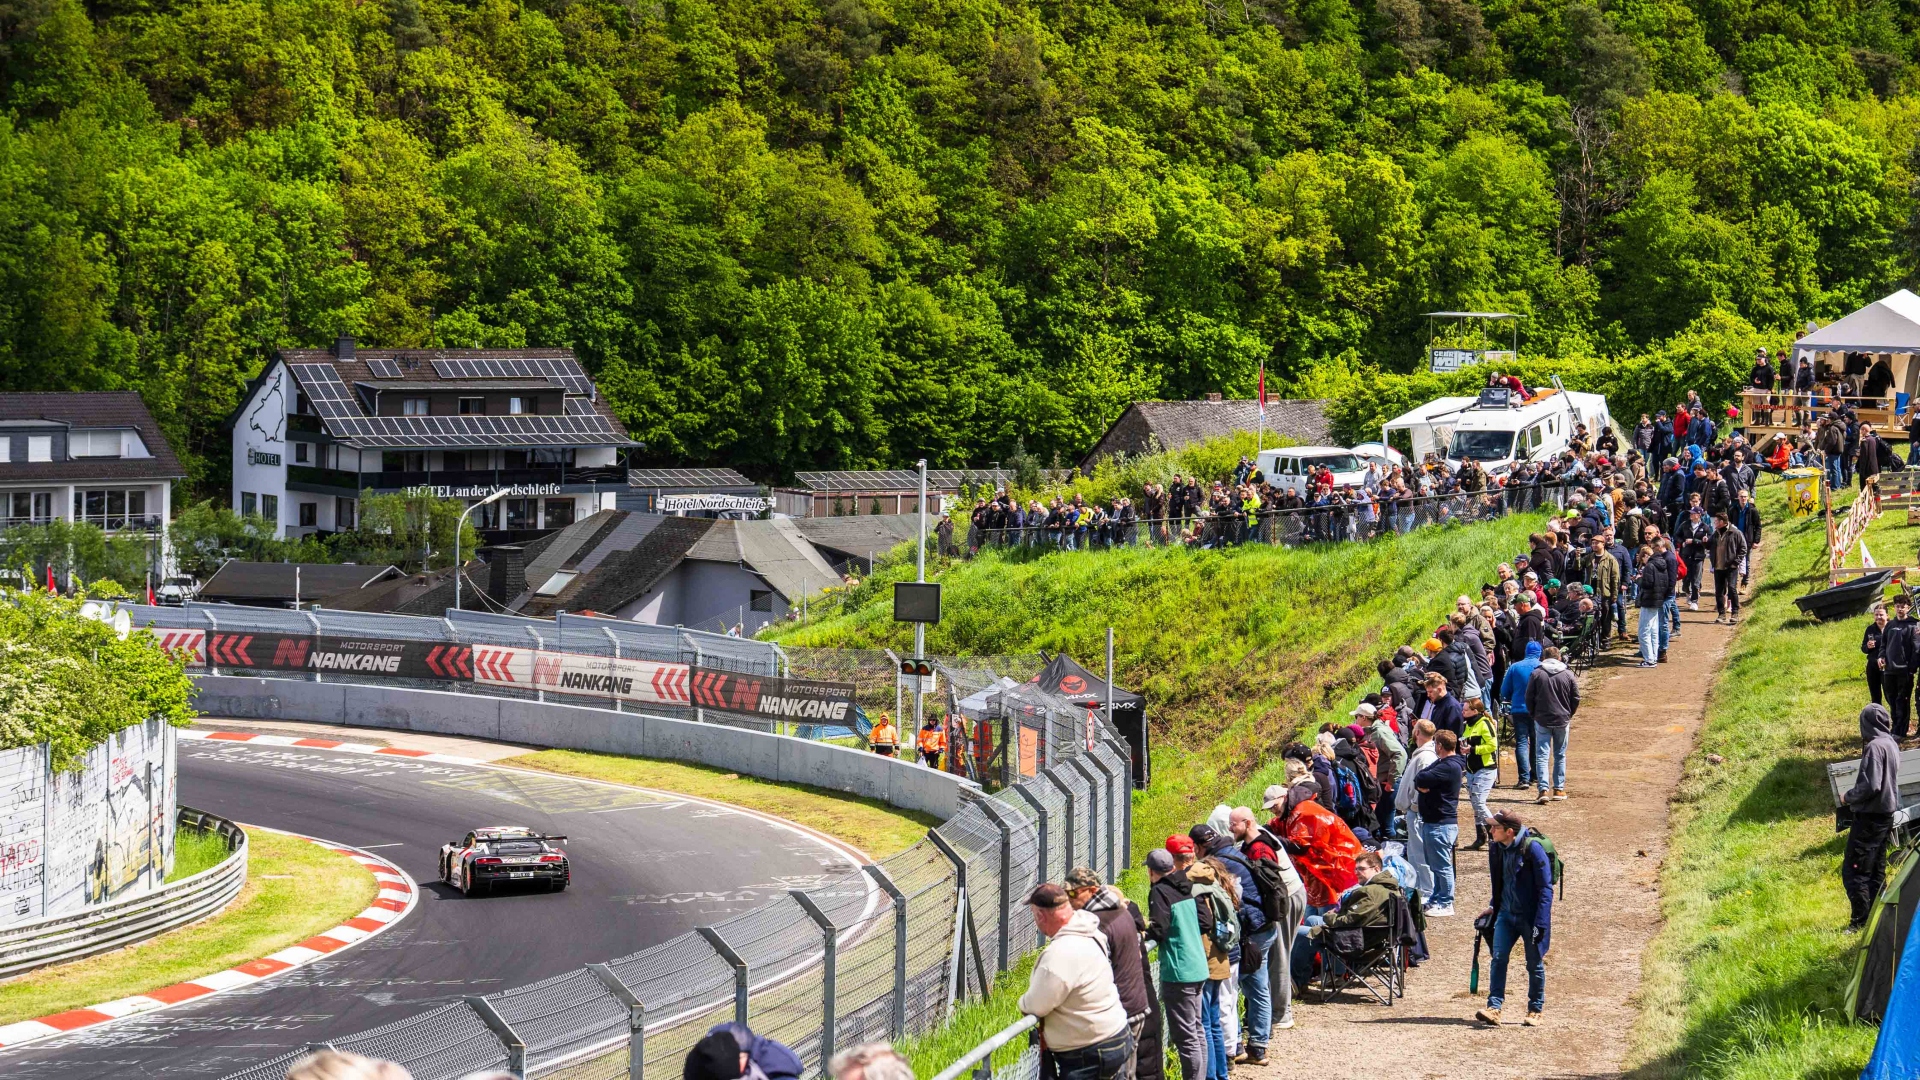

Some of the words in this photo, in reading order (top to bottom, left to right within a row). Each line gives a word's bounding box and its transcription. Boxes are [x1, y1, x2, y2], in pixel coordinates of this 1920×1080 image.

[255, 452, 280, 466] HOTEL
[470, 484, 489, 497] der
[490, 483, 561, 498] Ndschleife
[699, 497, 766, 510] Nordschleife
[340, 642, 405, 652] MOTORSPORT
[308, 652, 402, 673] NANKANG
[586, 661, 637, 673] MOTORSPORT
[560, 671, 633, 695] NANKANG
[784, 684, 853, 698] MOTORSPORT
[759, 695, 849, 720] NANKANG
